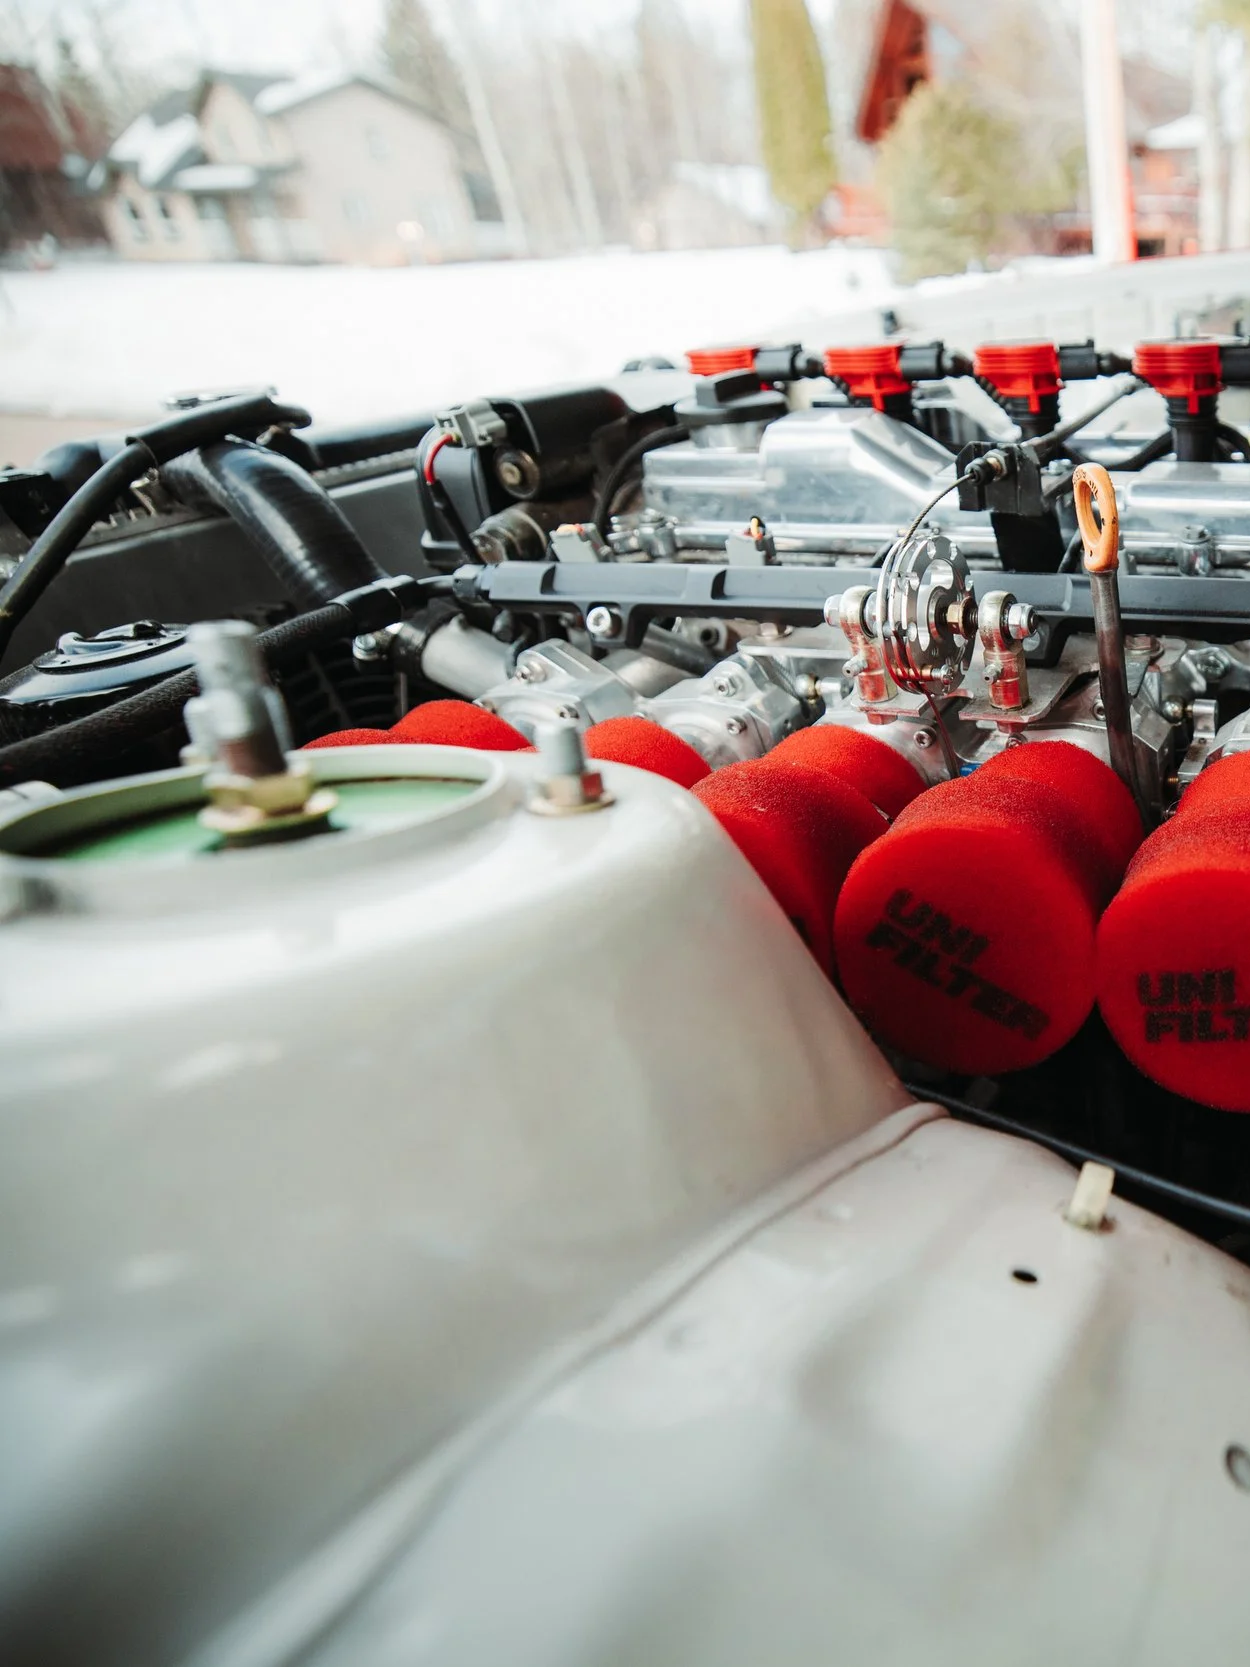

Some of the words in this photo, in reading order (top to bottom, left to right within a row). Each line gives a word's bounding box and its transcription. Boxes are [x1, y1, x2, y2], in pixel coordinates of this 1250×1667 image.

[884, 888, 989, 964] UNI
[865, 921, 1050, 1042] FILTER
[1138, 968, 1236, 1006] UNI
